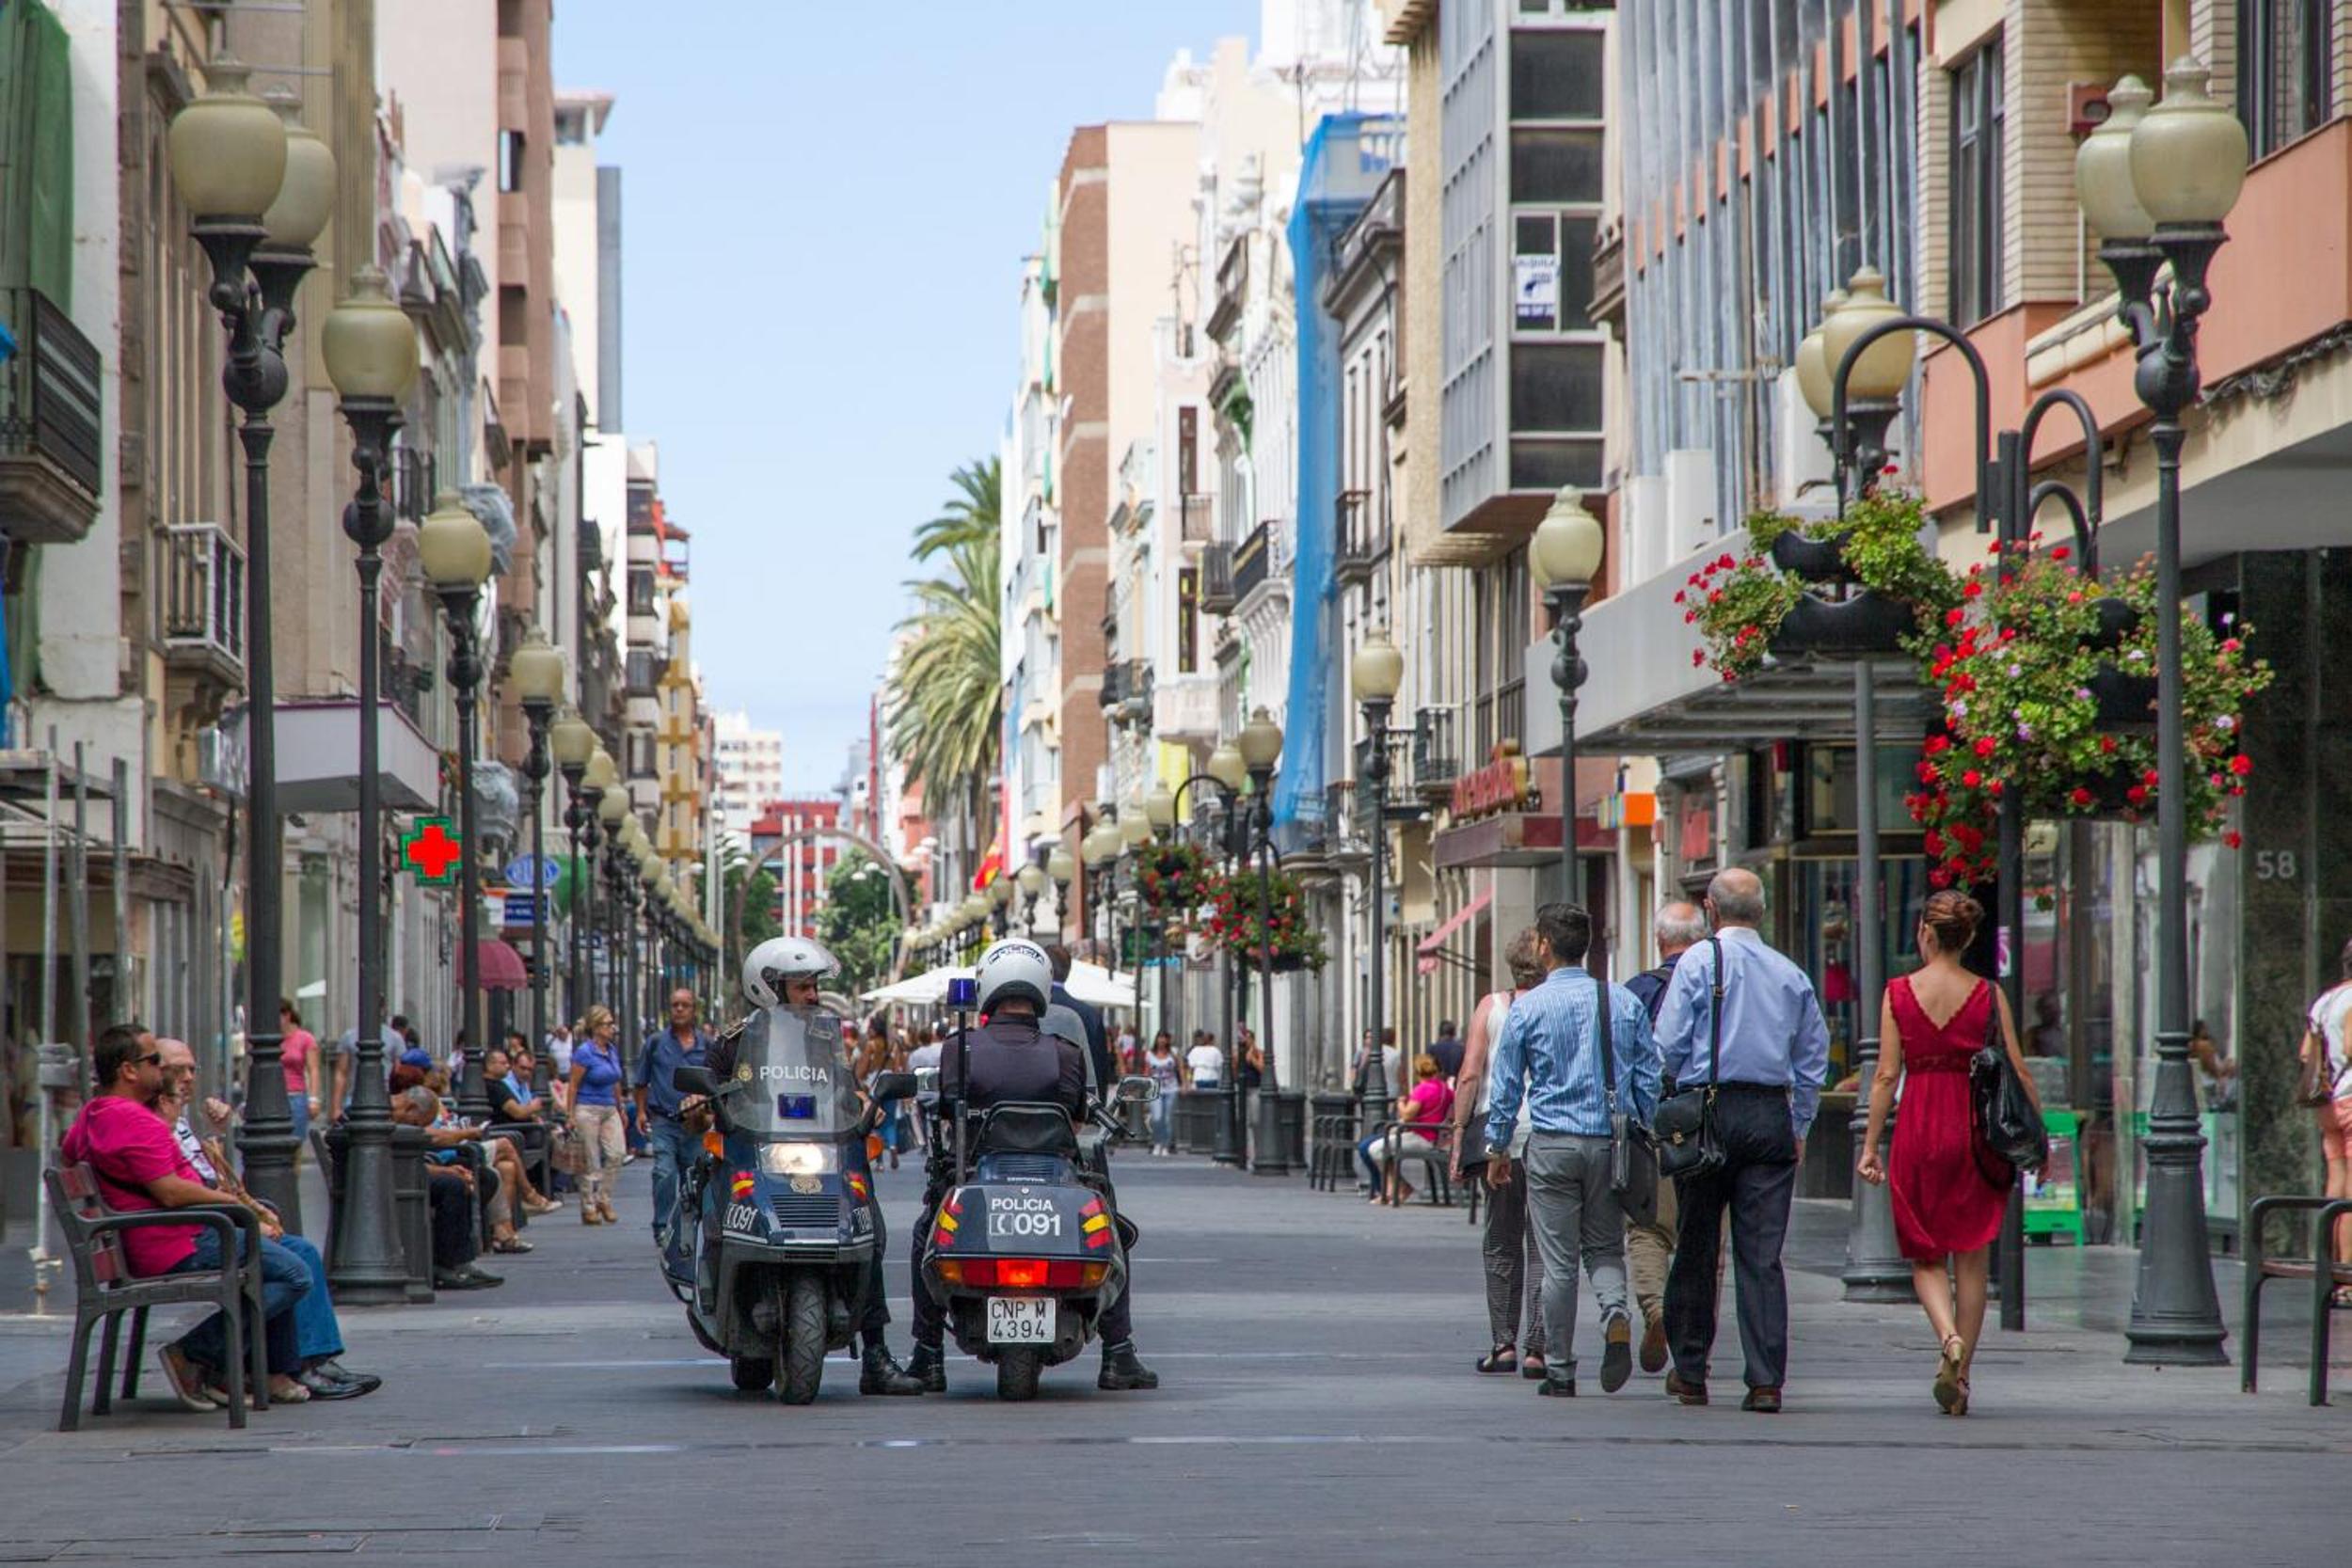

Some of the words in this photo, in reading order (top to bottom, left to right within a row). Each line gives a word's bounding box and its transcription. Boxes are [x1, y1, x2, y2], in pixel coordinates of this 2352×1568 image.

[2257, 850, 2296, 879] 58
[759, 1065, 828, 1083] POLICIA
[992, 1197, 1054, 1212] POLICIA
[733, 1204, 758, 1231] 091
[1015, 1213, 1060, 1236] 091
[992, 1300, 1026, 1320] CNP
[1035, 1301, 1045, 1319] M
[993, 1319, 1045, 1338] 4394
